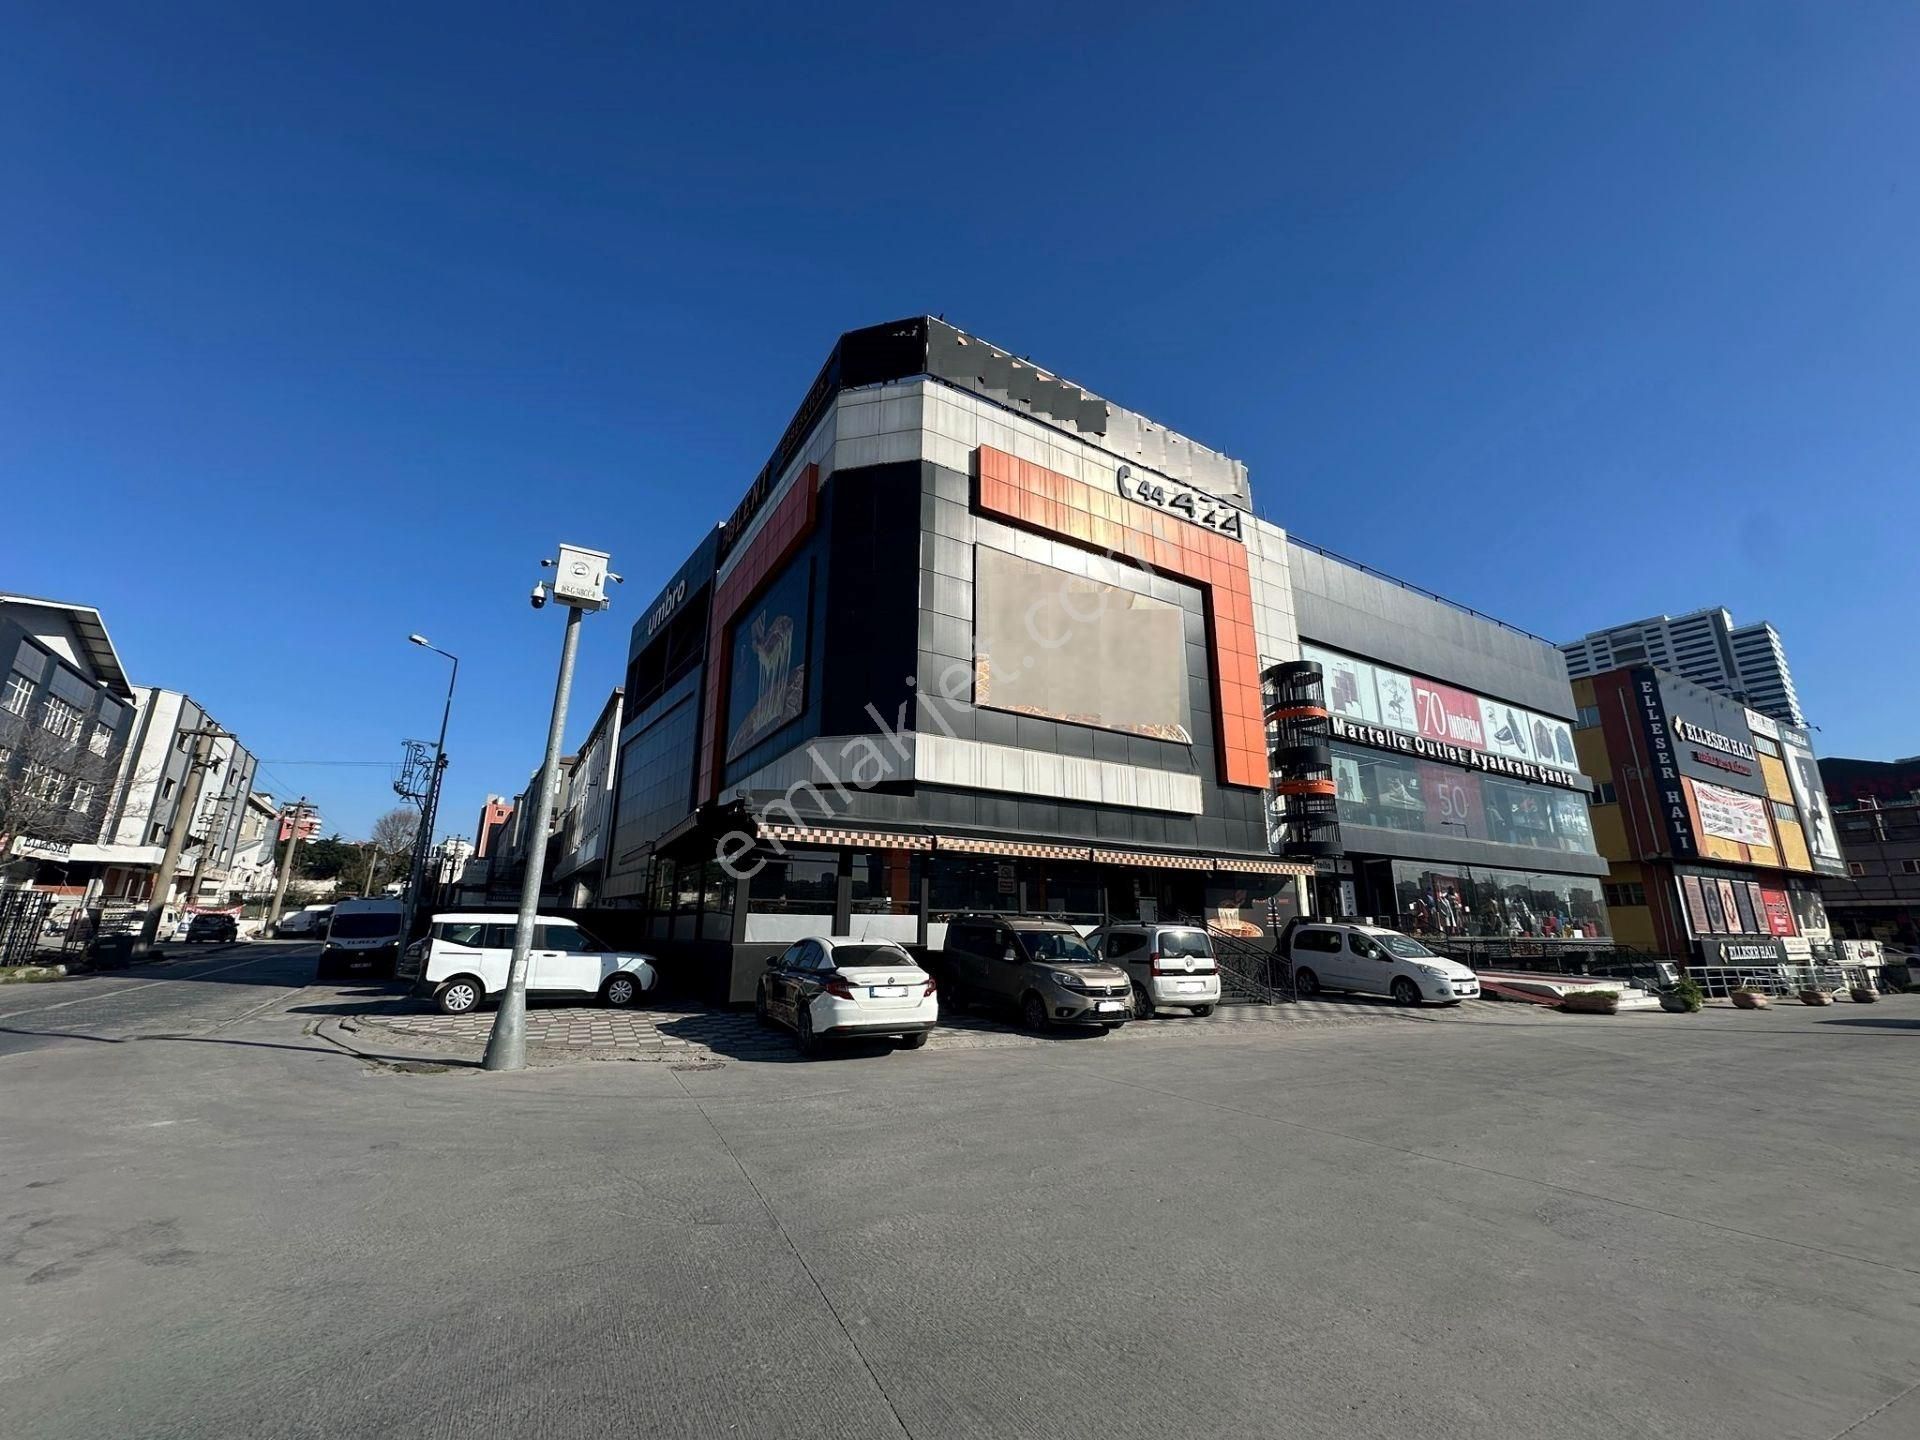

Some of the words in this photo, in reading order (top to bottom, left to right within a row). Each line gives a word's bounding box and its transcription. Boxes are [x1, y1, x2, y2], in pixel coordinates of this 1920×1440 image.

[648, 579, 686, 636] umbro
[1416, 688, 1446, 736] 70
[1332, 716, 1408, 749] Martello
[1414, 736, 1465, 763] Outlet
[1470, 748, 1537, 778] Ayakkabı
[1539, 765, 1575, 786] Çanta
[1685, 722, 1733, 755] ELLESER
[1730, 739, 1756, 761] HALI
[1641, 681, 1675, 779] ELLESER
[1666, 790, 1689, 849] HALI
[1437, 783, 1469, 818] 50
[24, 836, 73, 855] ELLESER
[1728, 946, 1760, 960] ELLESER
[1760, 945, 1778, 959] HALI
